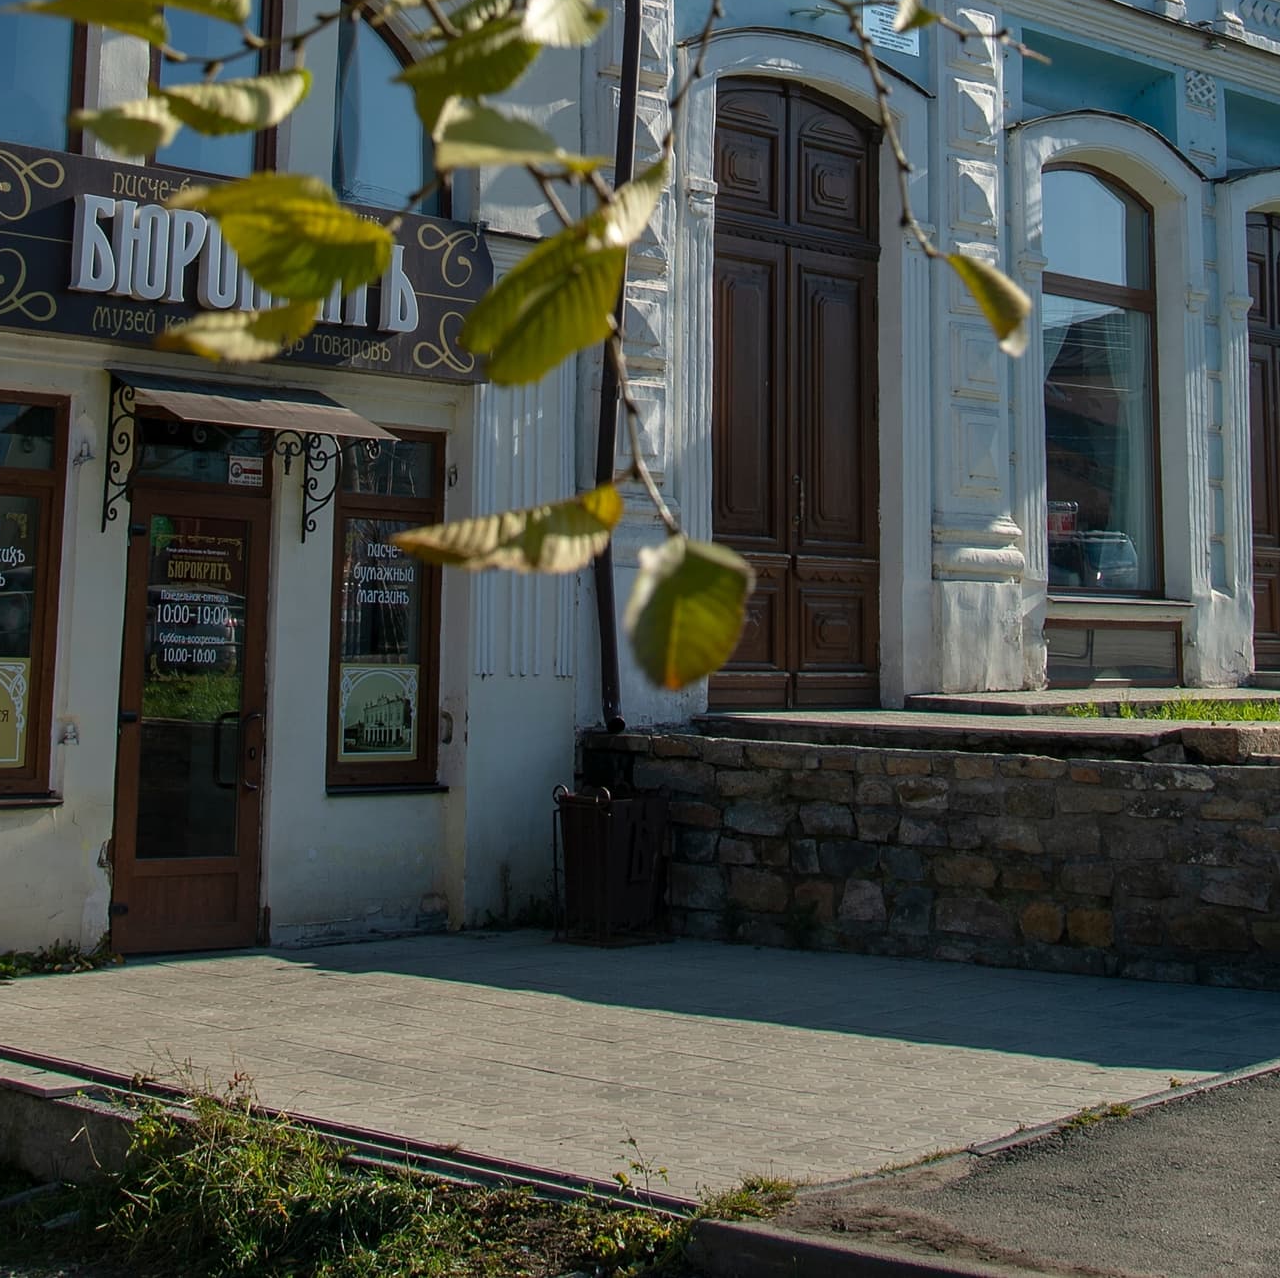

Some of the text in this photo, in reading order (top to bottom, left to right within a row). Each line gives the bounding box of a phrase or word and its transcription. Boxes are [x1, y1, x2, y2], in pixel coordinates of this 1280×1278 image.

[313, 334, 392, 367] товаровъ
[167, 560, 232, 581] БЮРОКРАТЪ
[354, 562, 414, 583] бумажный
